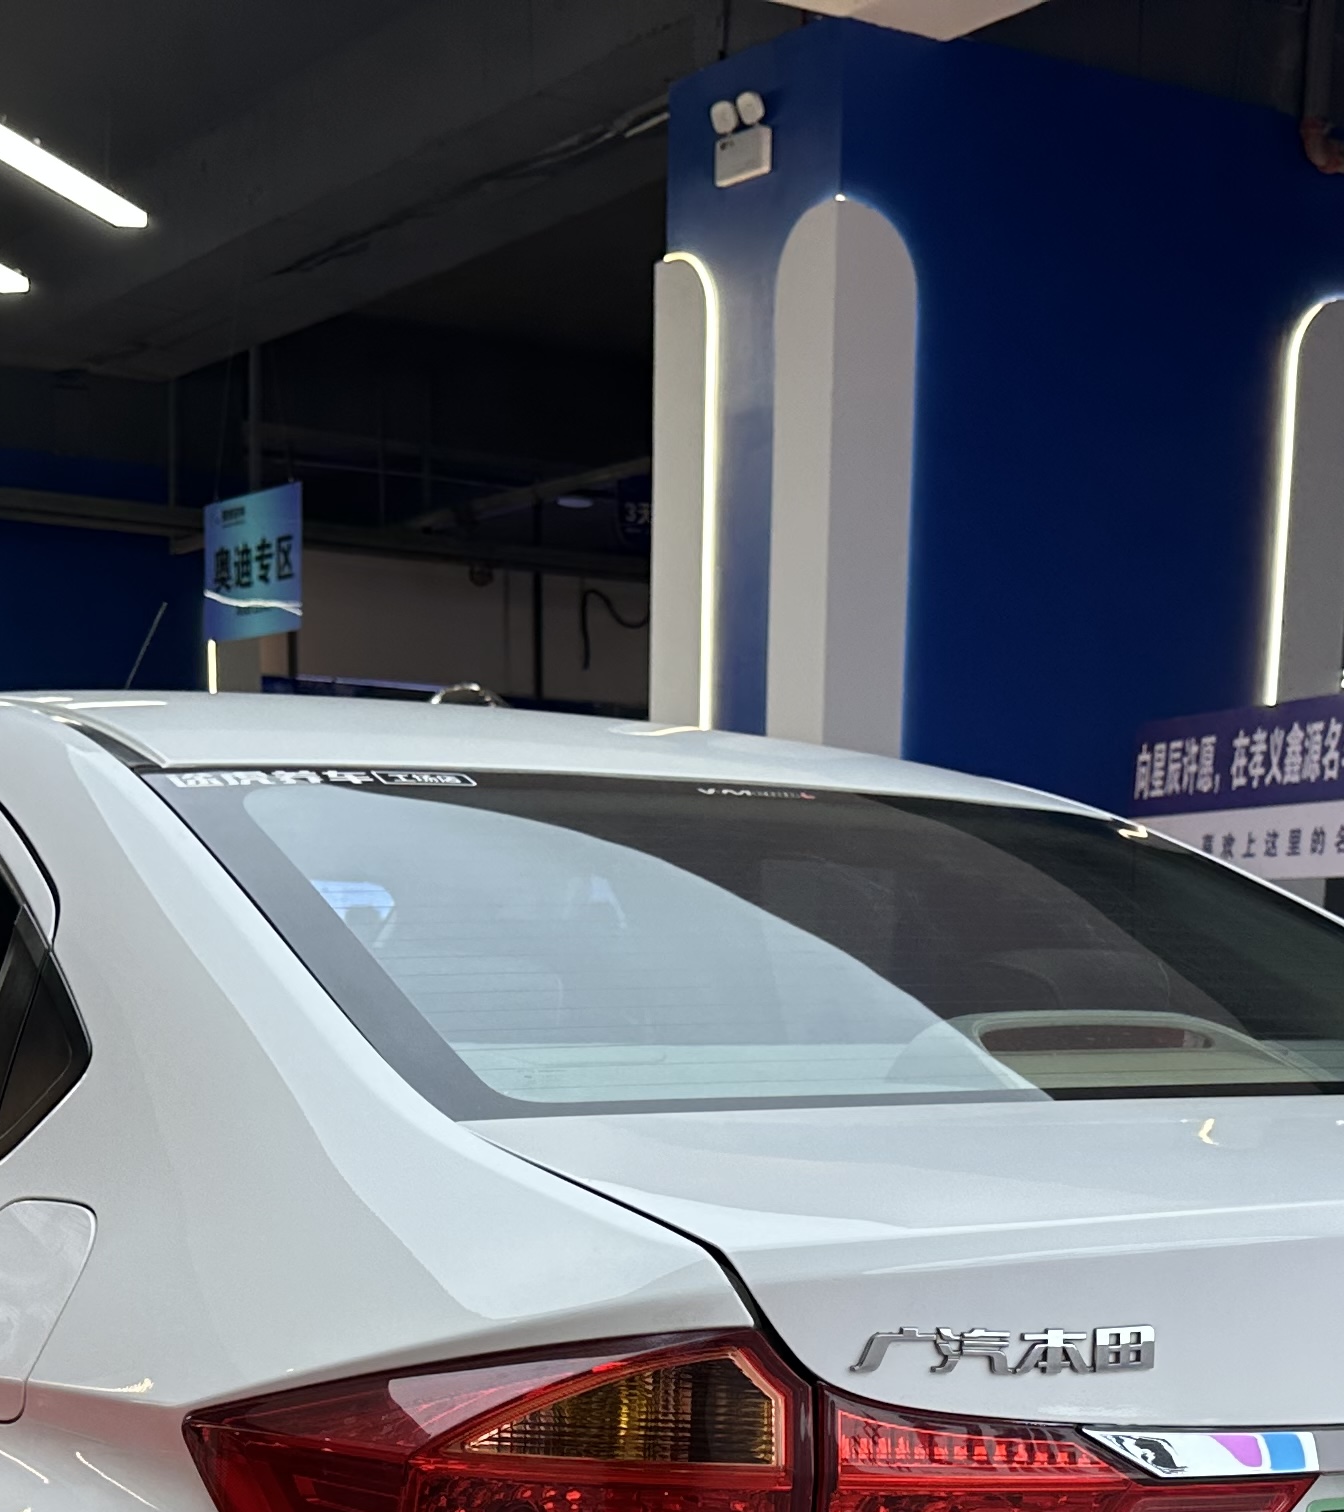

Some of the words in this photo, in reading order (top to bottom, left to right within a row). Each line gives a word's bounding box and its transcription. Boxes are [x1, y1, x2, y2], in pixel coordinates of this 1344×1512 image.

[213, 534, 295, 594] 奥迪专区
[849, 1324, 1156, 1375] 广汽本田
